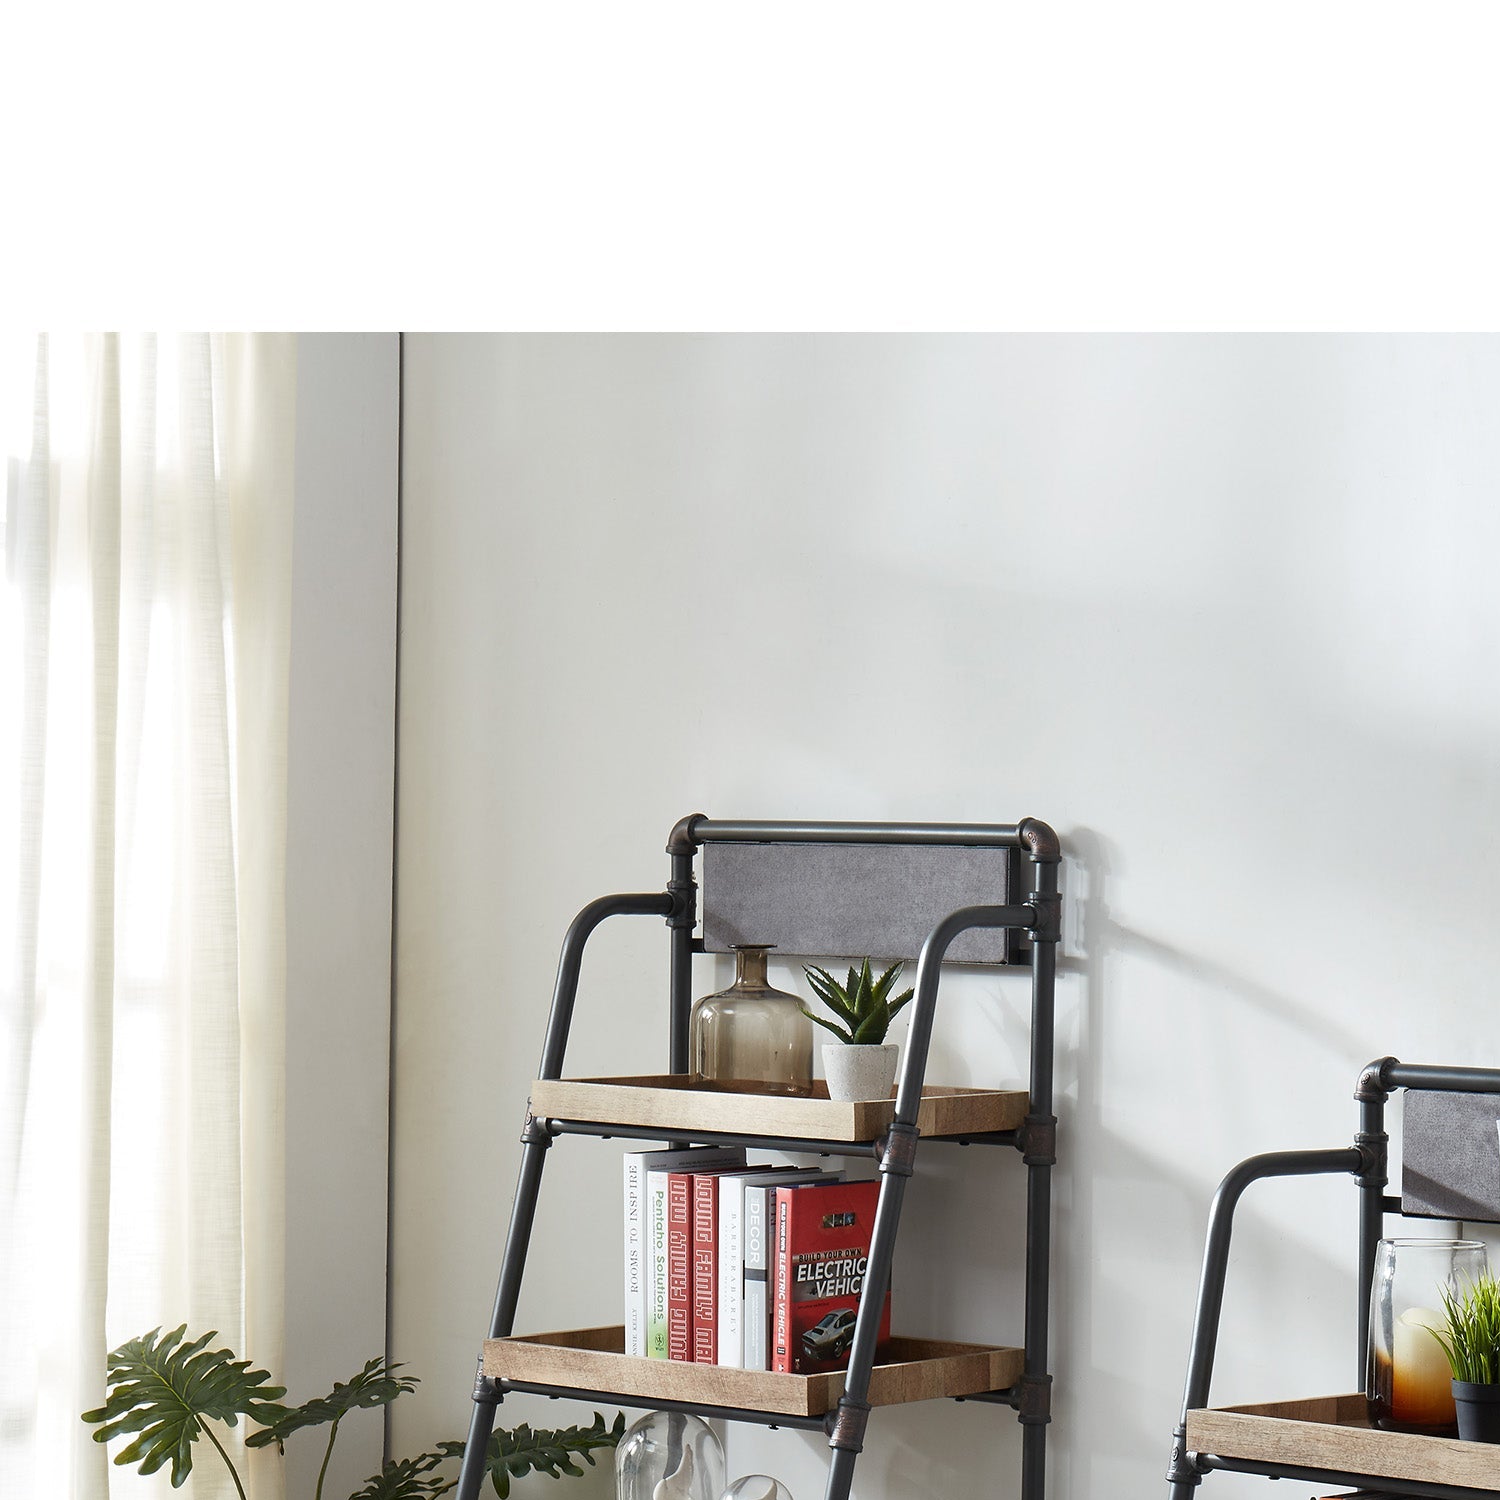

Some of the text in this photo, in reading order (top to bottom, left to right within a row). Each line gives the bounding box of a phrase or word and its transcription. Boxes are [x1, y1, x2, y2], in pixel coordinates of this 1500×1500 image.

[630, 1228, 638, 1243] TO
[655, 1191, 664, 1249] Pentaho
[750, 1203, 760, 1263] DECOR
[630, 1250, 639, 1293] ROOMS
[797, 1256, 868, 1282] ELECTRIC
[799, 1247, 862, 1263] BUILD YOUR OWN
[656, 1256, 665, 1320] Solutions
[816, 1275, 866, 1298] VEHIC
